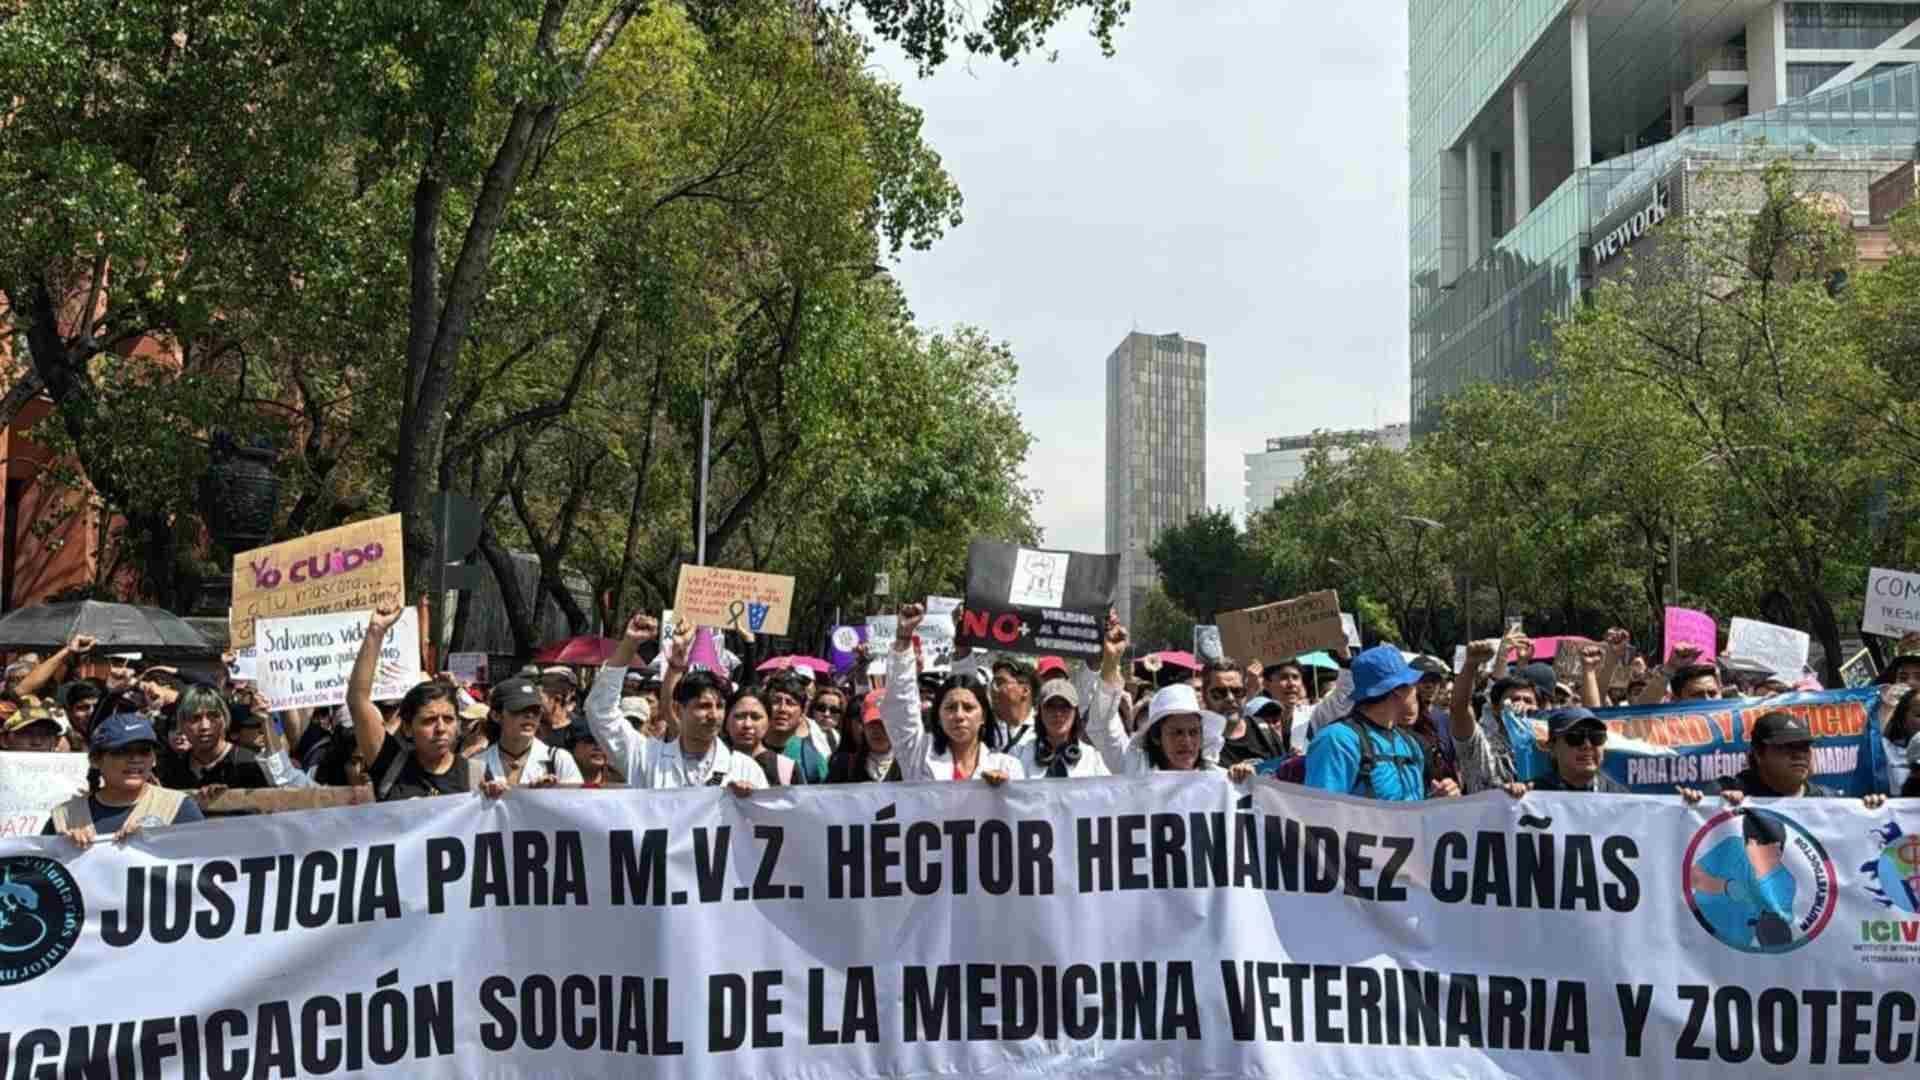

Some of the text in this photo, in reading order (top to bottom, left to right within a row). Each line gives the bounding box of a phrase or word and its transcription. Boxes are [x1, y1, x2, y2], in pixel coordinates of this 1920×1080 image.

[1592, 181, 1667, 264] wework
[1627, 758, 1667, 784] PARA
[1671, 755, 1698, 782] LOS
[100, 797, 1641, 947] JUSTICIA PARA M.V.Z. HÉCTOR HERNÁNDEZ CAÑAS
[479, 974, 684, 1056] SOCIAL
[708, 970, 784, 1053] DE
[808, 966, 880, 1045] LA
[903, 960, 1201, 1042] MEDICINA
[1220, 960, 1590, 1054] VETERINARIA
[1616, 984, 1653, 1057] Y
[1676, 985, 1920, 1065] ZOOTEC
